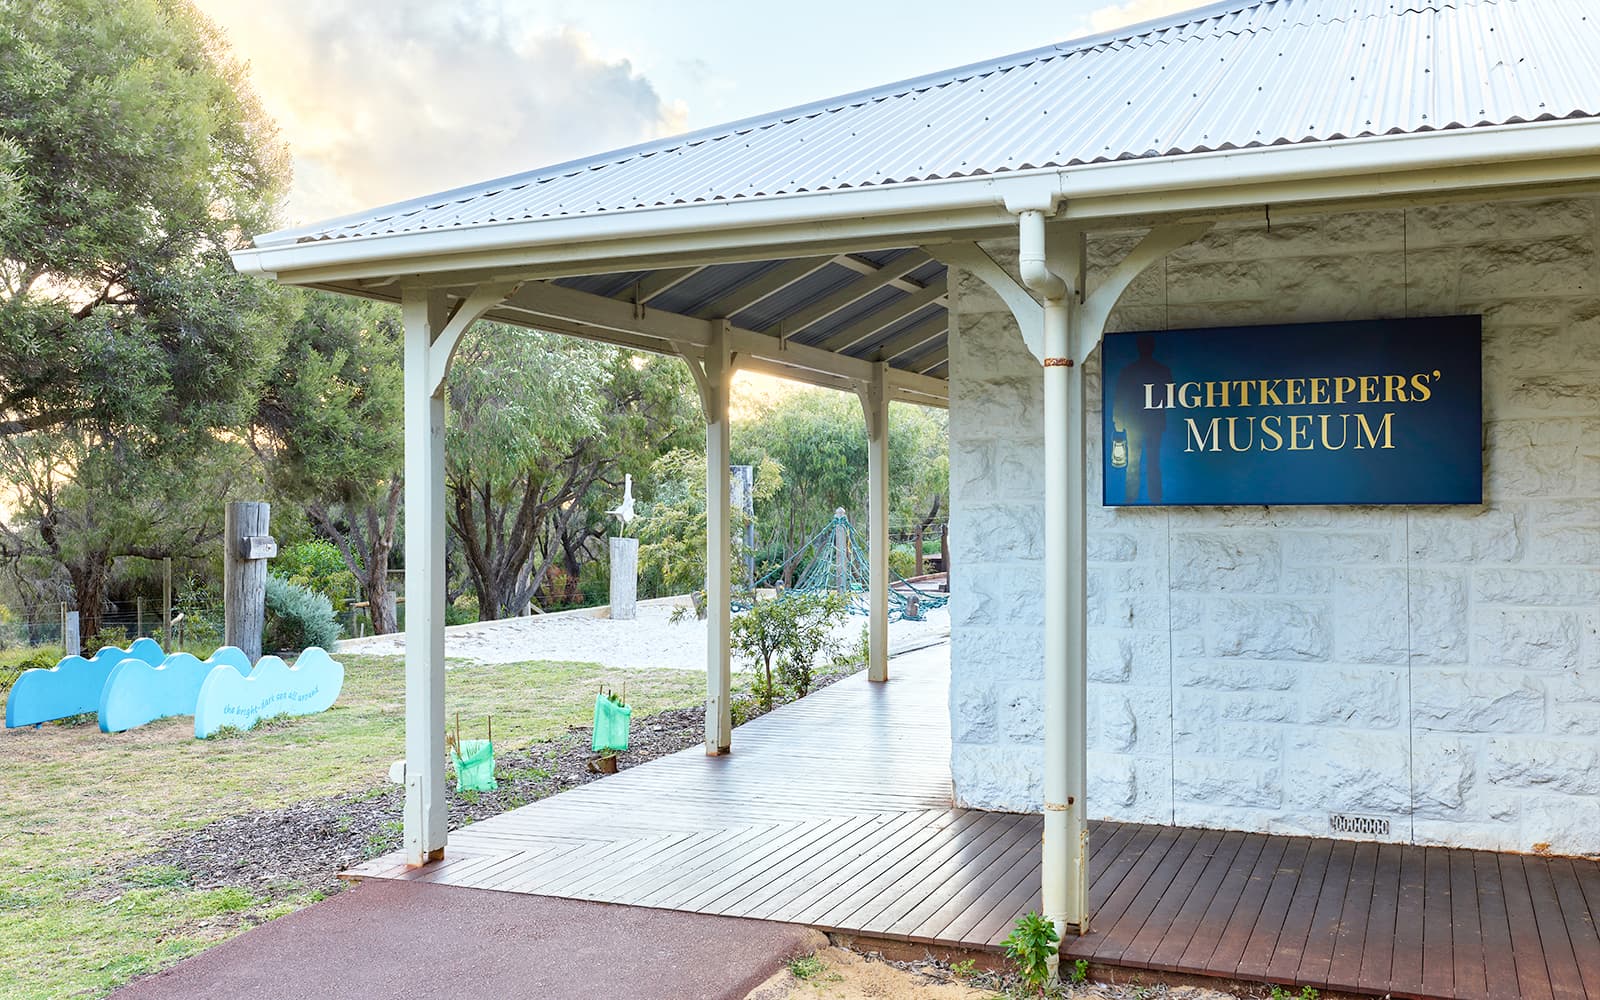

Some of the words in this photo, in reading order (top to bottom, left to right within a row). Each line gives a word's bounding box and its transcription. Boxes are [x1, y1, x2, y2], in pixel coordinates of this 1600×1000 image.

[1143, 370, 1441, 410] LIGHTKEEPERS’
[1183, 412, 1396, 453] MUSEUM
[224, 704, 235, 714] the
[288, 690, 298, 701] all
[298, 684, 319, 702] around
